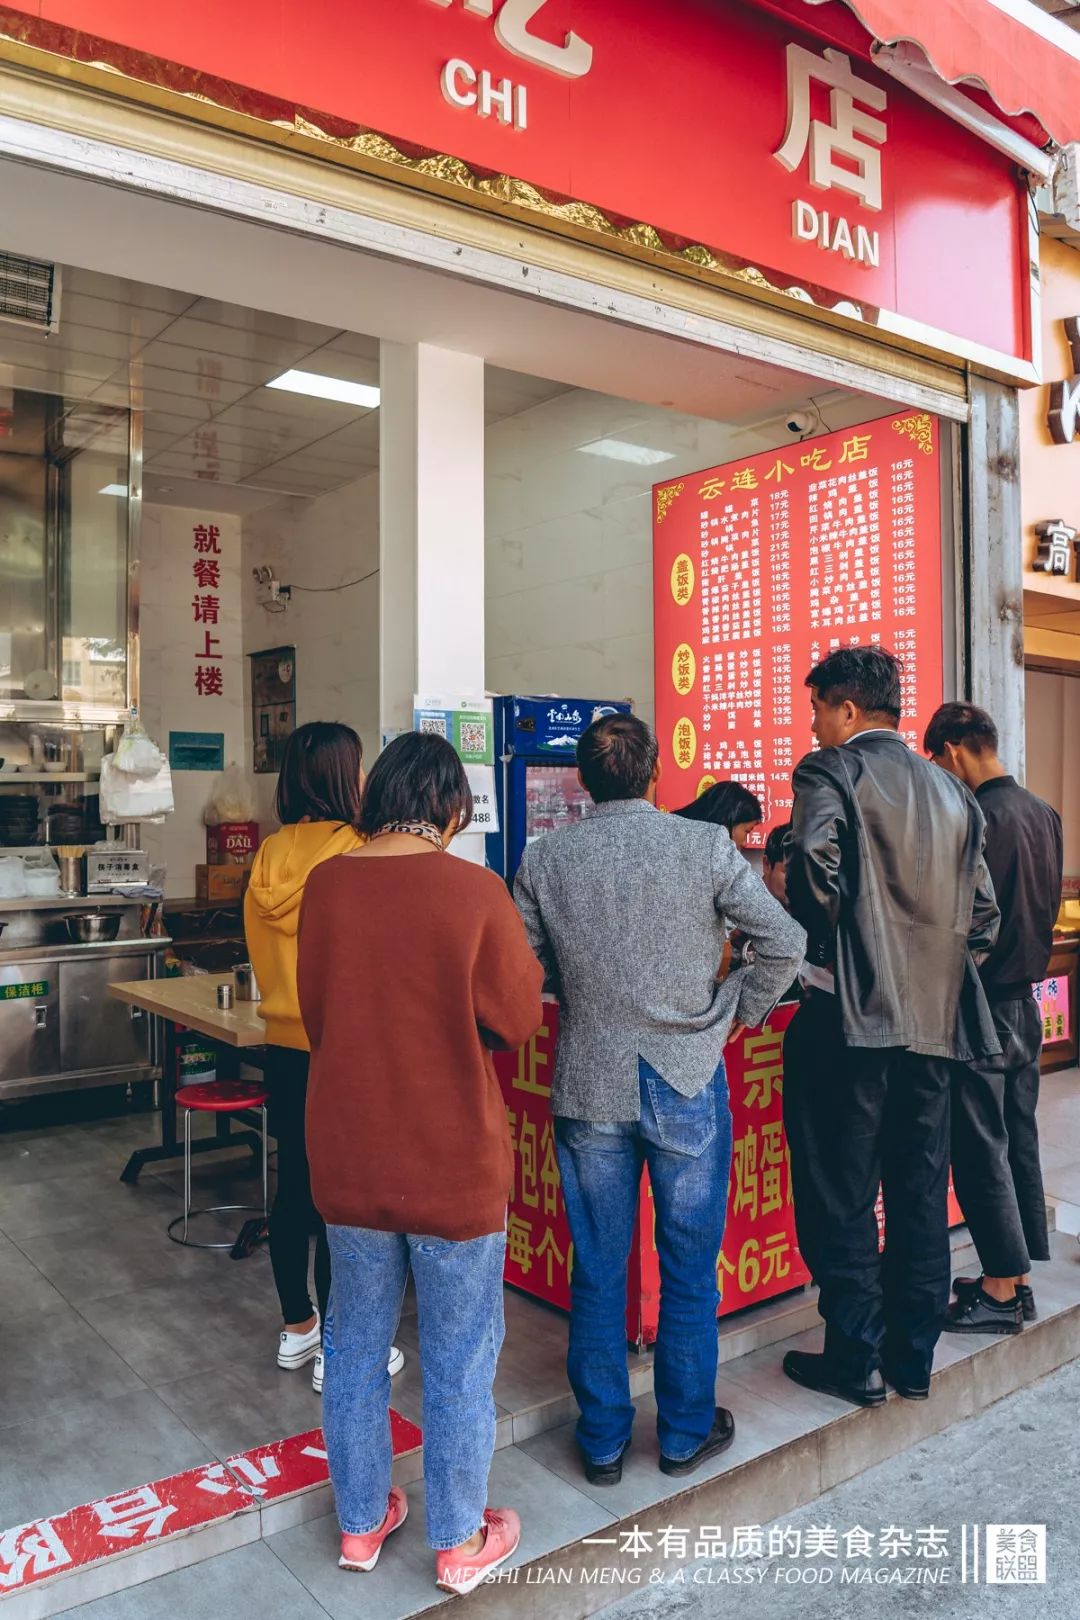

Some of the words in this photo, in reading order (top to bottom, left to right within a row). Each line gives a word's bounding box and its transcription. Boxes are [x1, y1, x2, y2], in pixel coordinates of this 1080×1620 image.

[442, 58, 527, 131] CHI
[772, 42, 887, 212] 店
[793, 199, 880, 268] DIAN
[698, 434, 873, 500] 云连小吃店
[891, 459, 914, 470] 16元
[891, 470, 914, 482] 16元
[891, 482, 914, 493] 16元
[770, 490, 789, 500] 18元
[891, 493, 914, 504] 16元
[770, 500, 789, 510] 17元
[891, 504, 914, 515] 16元
[770, 510, 789, 520] 17元
[771, 521, 789, 531] 17元
[892, 516, 915, 527] 16元
[771, 531, 790, 541] 17元
[892, 527, 915, 538] 16元
[771, 541, 790, 551] 21元
[892, 538, 915, 549] 16元
[1045, 520, 1078, 576] 高
[771, 552, 790, 561] 21元
[892, 550, 915, 561] 16元
[772, 562, 790, 572] 16元
[772, 572, 790, 582] 16元
[810, 567, 880, 587] 小炒肉盖饭
[892, 560, 915, 572] 16元
[892, 572, 915, 583] 16元
[676, 560, 690, 601] 盖饭类
[772, 582, 790, 592] 16元
[892, 583, 915, 594] 16元
[772, 592, 791, 602] 16元
[892, 594, 915, 605] 16元
[192, 524, 223, 697] 就餐请上楼
[772, 603, 791, 613] 16元
[773, 613, 791, 623] 16元
[811, 611, 881, 629] 木耳肉丝盖饭
[892, 606, 916, 616] 16元
[773, 623, 791, 633] 16元
[894, 629, 916, 639] 15元
[772, 644, 792, 654] 16元
[894, 640, 916, 650] 15元
[772, 654, 792, 664] 16元
[677, 649, 691, 690] 炒饭类
[772, 664, 792, 674] 14元
[772, 675, 792, 684] 13元
[900, 674, 917, 683] 3元
[772, 685, 792, 694] 13元
[900, 685, 917, 694] 3元
[772, 695, 792, 705] 13元
[900, 697, 917, 706] 3元
[772, 706, 792, 715] 13元
[900, 708, 917, 717] 3元
[772, 716, 792, 725] 13元
[677, 724, 691, 764] 泡饭类
[704, 739, 762, 751] 土鸡泡饭
[773, 737, 792, 746] 18元
[774, 757, 792, 767] 13元
[770, 772, 789, 781] 14元
[774, 799, 794, 809] 13元
[5, 983, 44, 998] 保洁柜
[511, 1025, 552, 1098] 正
[743, 1025, 784, 1109] 宗
[506, 1213, 574, 1287] 每个
